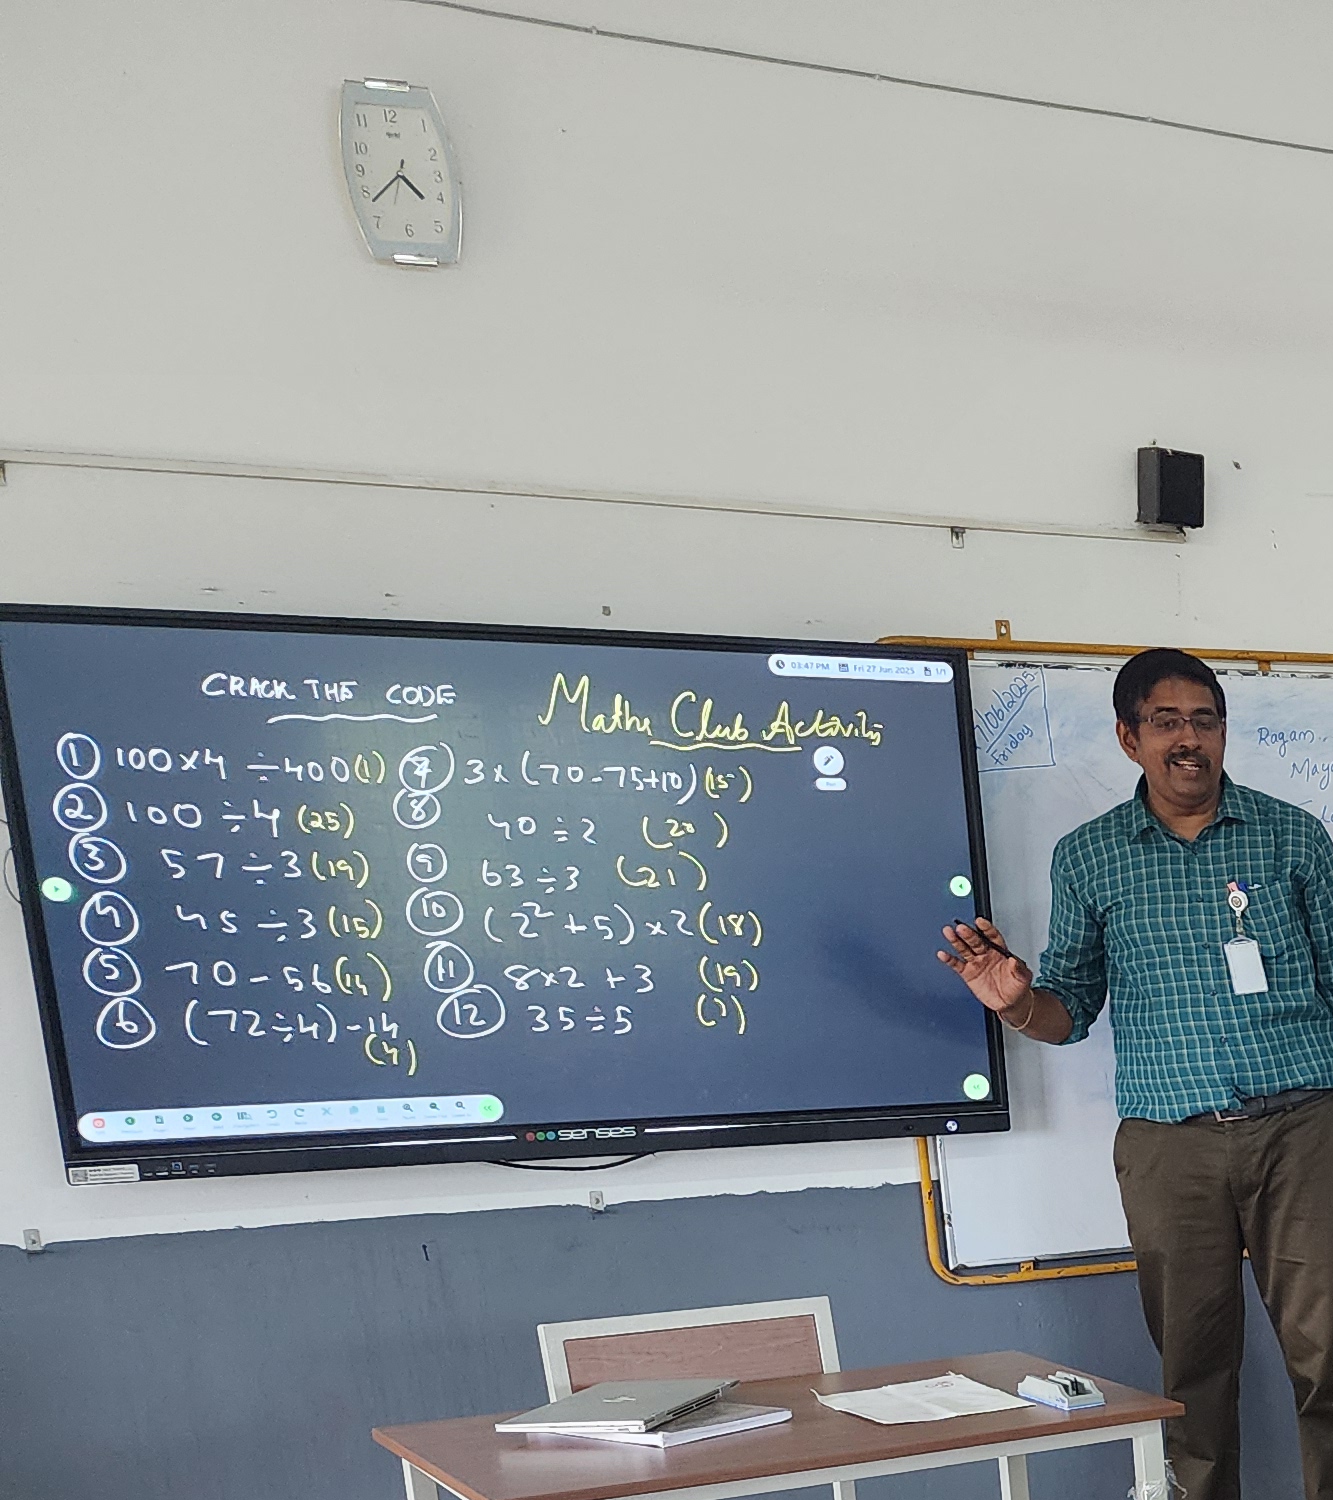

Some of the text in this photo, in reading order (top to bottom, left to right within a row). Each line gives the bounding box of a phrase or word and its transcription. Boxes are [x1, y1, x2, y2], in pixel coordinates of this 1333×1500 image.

[356, 113, 368, 128] 11
[383, 108, 397, 124] 12
[420, 118, 428, 133] 1
[354, 141, 368, 155] 10
[428, 147, 437, 162] 2
[355, 164, 365, 177] 9
[434, 170, 443, 183] 3
[361, 185, 370, 198] 8
[436, 191, 445, 204] 4
[372, 215, 382, 229] 7
[434, 220, 444, 233] 5
[404, 223, 415, 238] 6
[816, 662, 830, 671] PM
[853, 664, 864, 673] Fri
[866, 665, 877, 673] 27
[895, 666, 915, 675] 2025
[936, 668, 947, 676] 1/1
[201, 672, 457, 706] CRACK THE CODE
[974, 670, 1038, 749] 7/06/2025
[671, 691, 750, 742] Club
[761, 700, 884, 746] Activity
[990, 724, 1034, 766] Friday
[558, 1126, 637, 1141] senses
